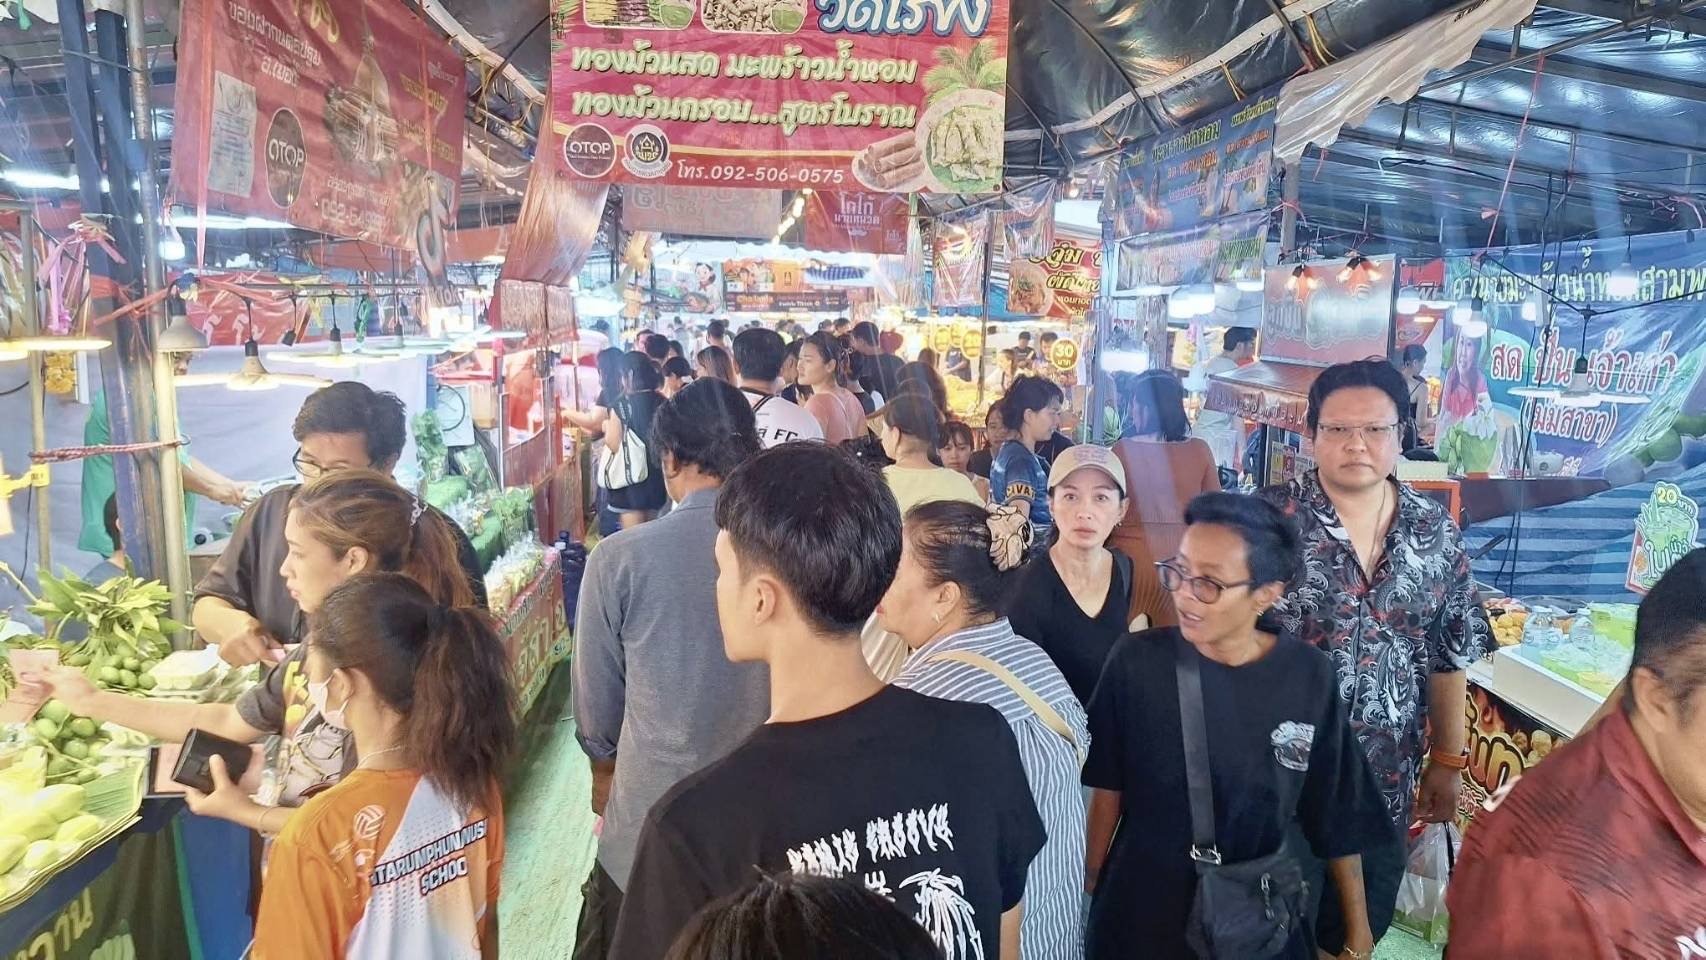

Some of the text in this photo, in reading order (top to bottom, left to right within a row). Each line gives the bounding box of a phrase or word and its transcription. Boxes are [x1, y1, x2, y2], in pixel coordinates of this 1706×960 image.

[572, 38, 917, 83] ทองม้วนสด มะพร้าวน้ำหอม
[269, 140, 306, 168] OTOP
[570, 141, 611, 155] OTOP
[676, 158, 844, 185] โทร.092-506-0575
[1055, 346, 1074, 358] 30
[1489, 344, 1523, 380] สด
[1586, 328, 1679, 396] เจ้าเก่า
[1656, 486, 1677, 504] 20
